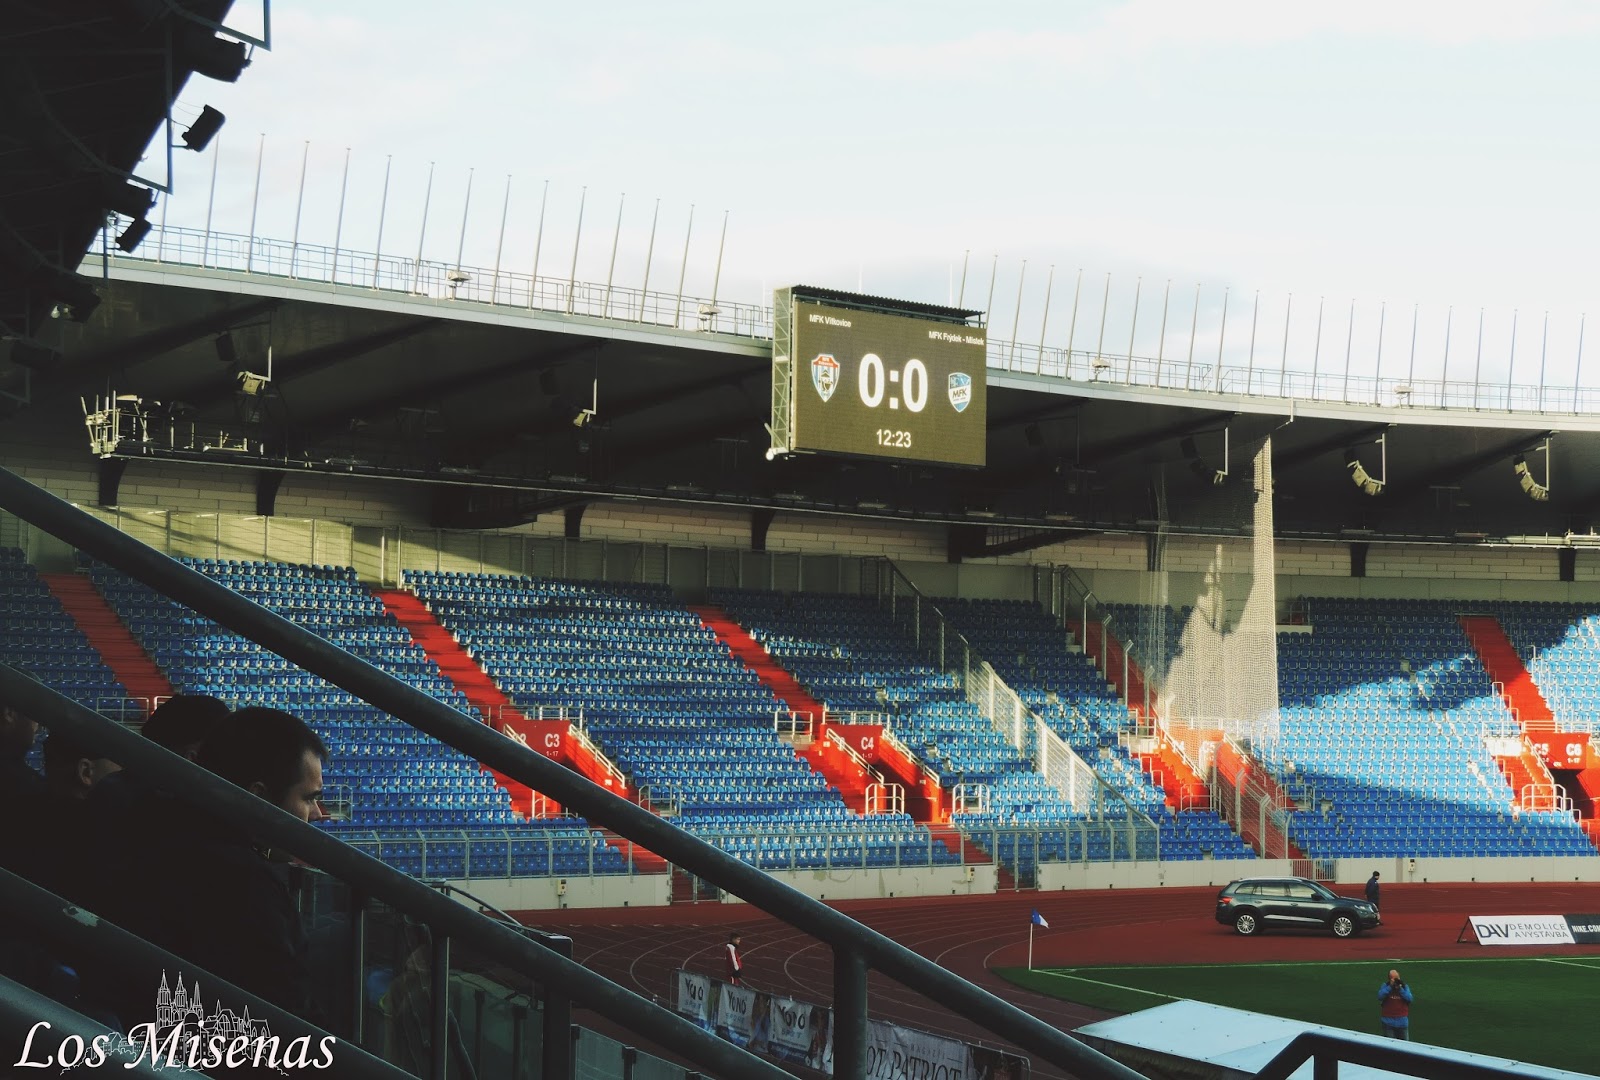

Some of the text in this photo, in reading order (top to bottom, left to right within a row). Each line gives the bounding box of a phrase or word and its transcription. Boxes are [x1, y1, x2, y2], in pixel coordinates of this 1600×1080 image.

[809, 313, 824, 324] MFK
[928, 330, 943, 340] MFK
[858, 353, 928, 413] 0:0
[952, 388, 967, 399] MFK
[876, 429, 912, 448] 12:23
[544, 733, 560, 747] C3
[860, 736, 874, 750] C4
[1475, 924, 1508, 938] DAV
